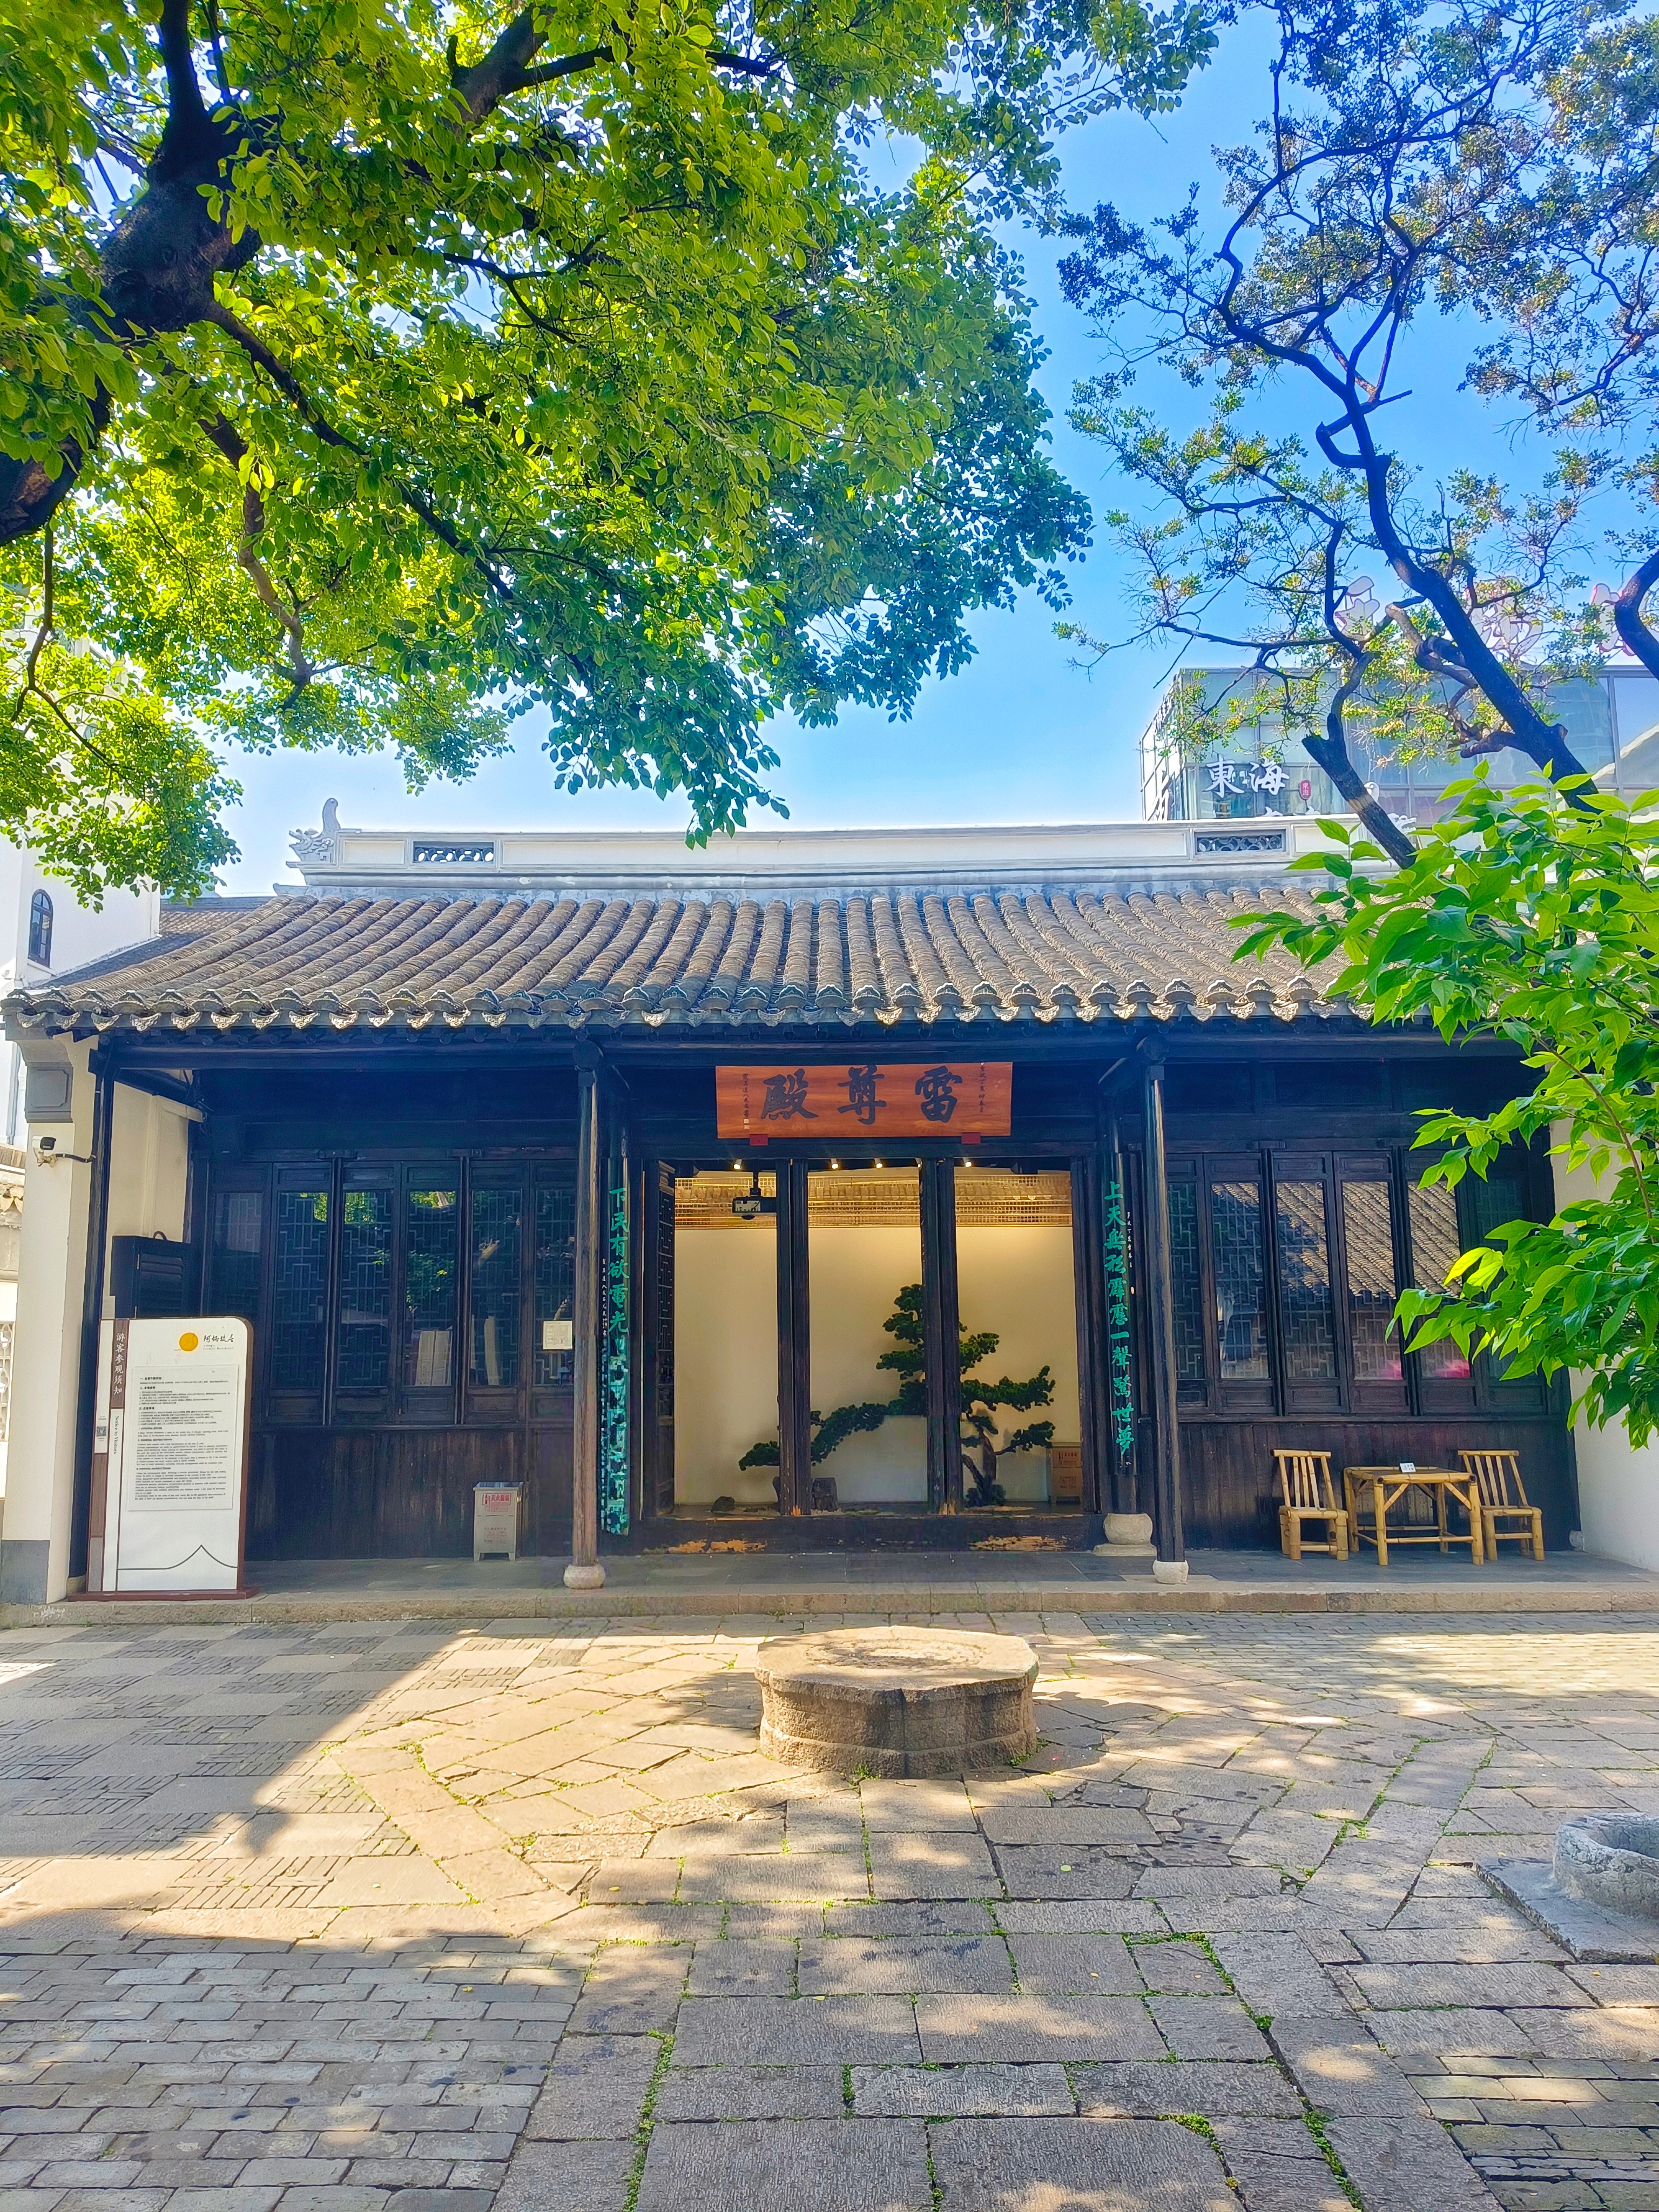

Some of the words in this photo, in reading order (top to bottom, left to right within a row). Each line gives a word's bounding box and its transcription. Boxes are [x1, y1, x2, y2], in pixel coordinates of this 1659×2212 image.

[1202, 756, 1290, 798] 東海
[113, 1333, 125, 1395] 游客参观须知
